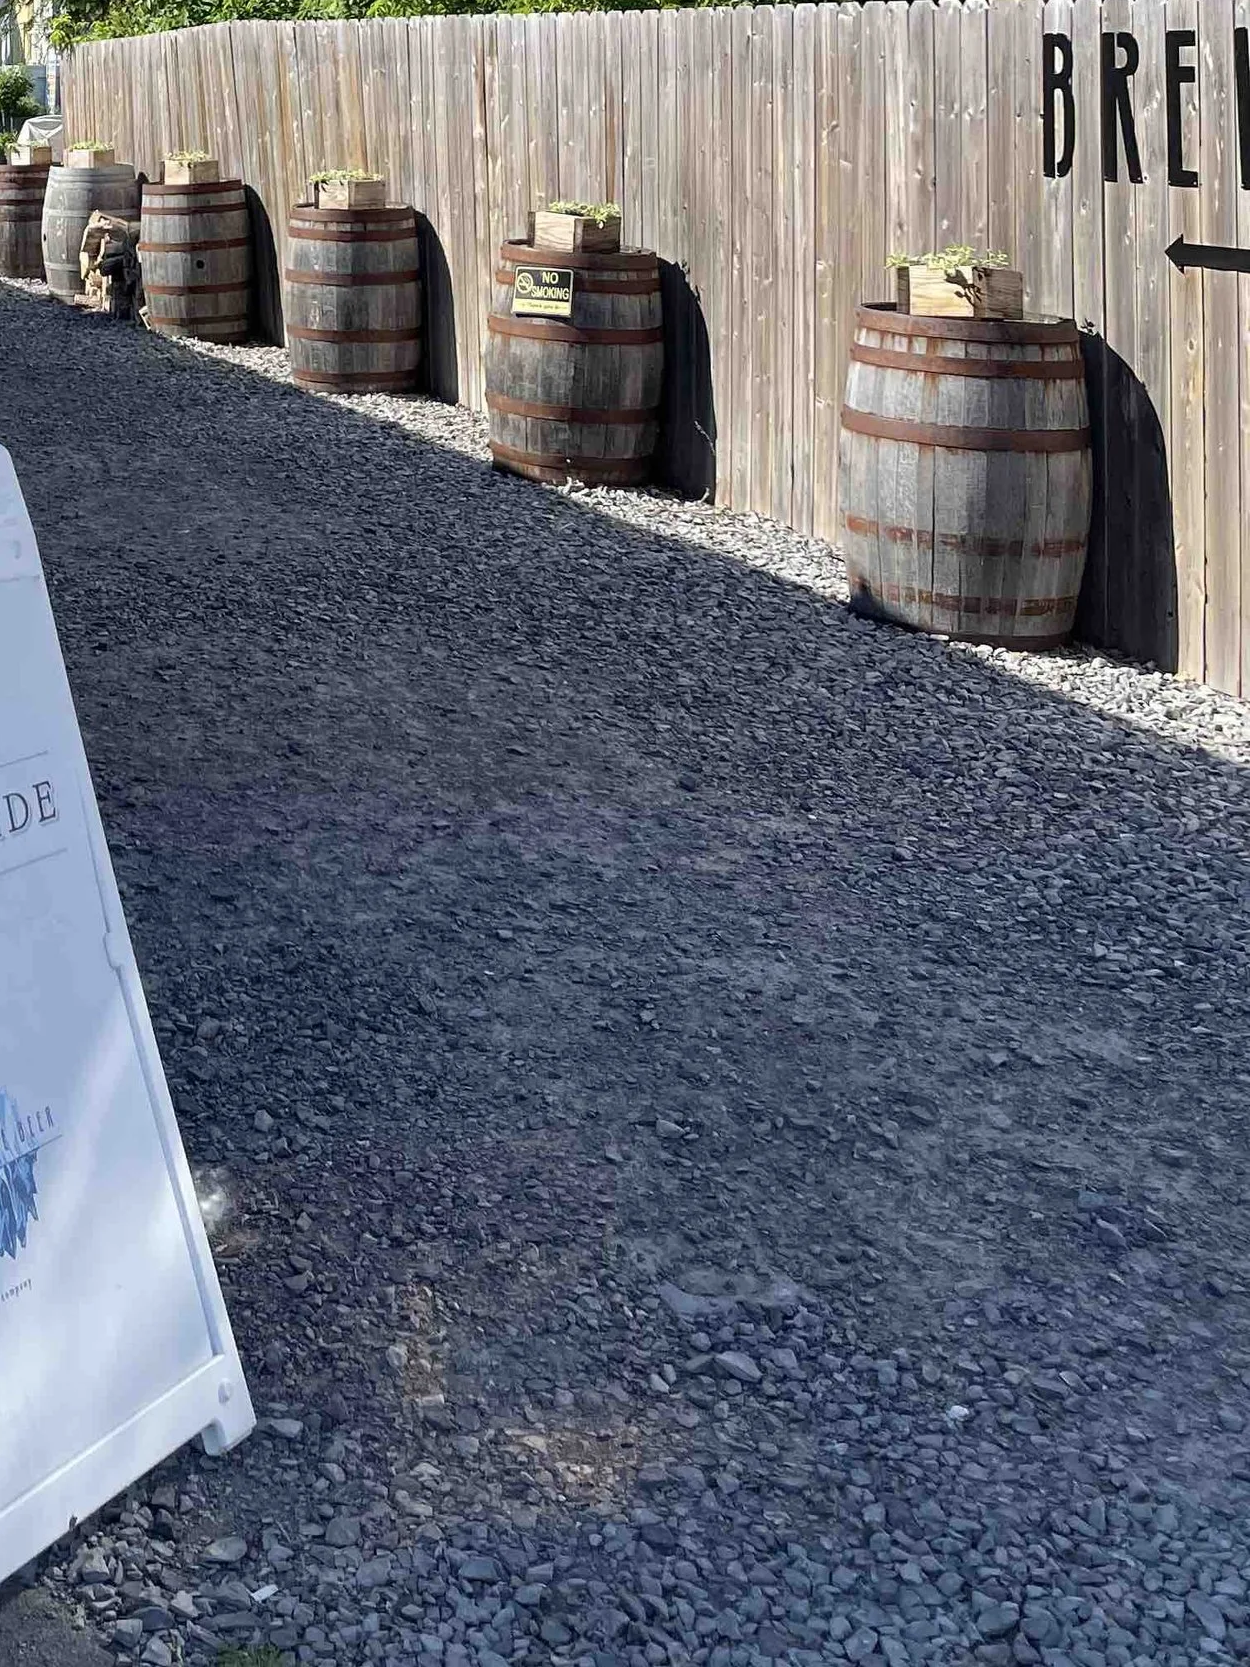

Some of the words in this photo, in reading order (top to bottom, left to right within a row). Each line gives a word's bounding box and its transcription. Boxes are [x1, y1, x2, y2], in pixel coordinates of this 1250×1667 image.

[1042, 27, 1250, 191] BRE
[542, 271, 559, 284] NO
[531, 285, 569, 300] SMOKING
